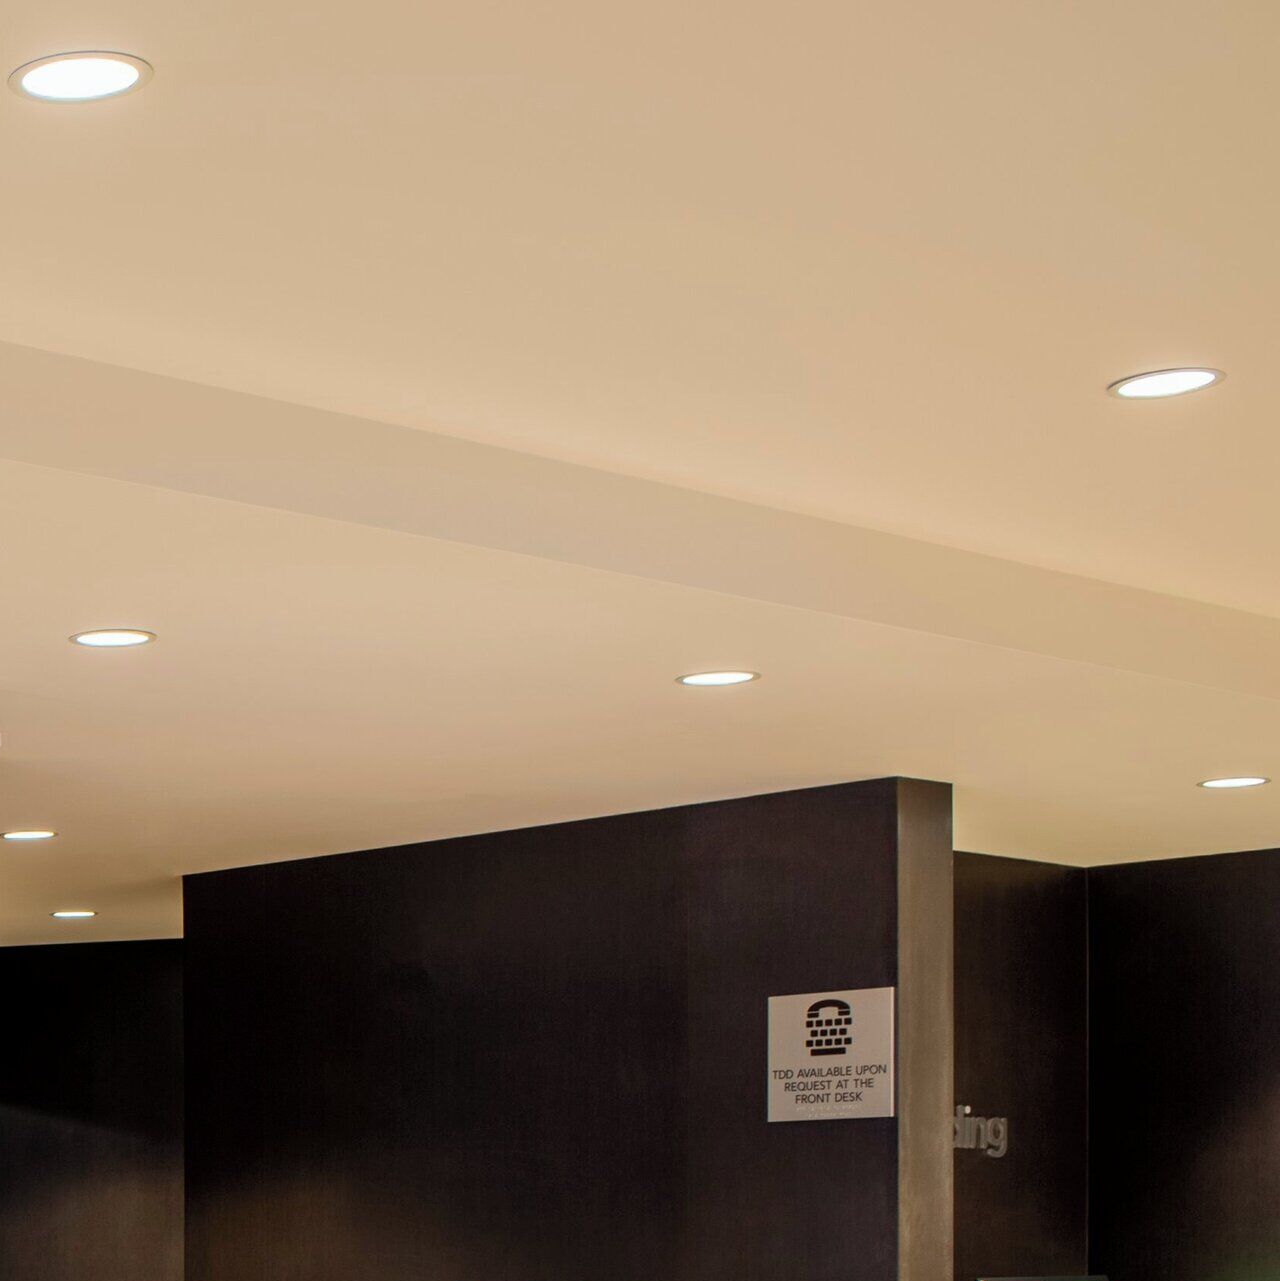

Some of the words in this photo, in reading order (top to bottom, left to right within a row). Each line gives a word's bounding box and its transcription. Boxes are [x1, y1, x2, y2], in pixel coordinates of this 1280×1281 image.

[772, 1069, 794, 1080] TDD
[796, 1065, 852, 1078] AVAILABLE
[855, 1064, 887, 1075] UPON
[784, 1080, 832, 1092] REQUEST
[835, 1079, 849, 1089] AT
[854, 1078, 874, 1088] THE
[795, 1093, 831, 1104] FRONT
[834, 1091, 863, 1102] DESK
